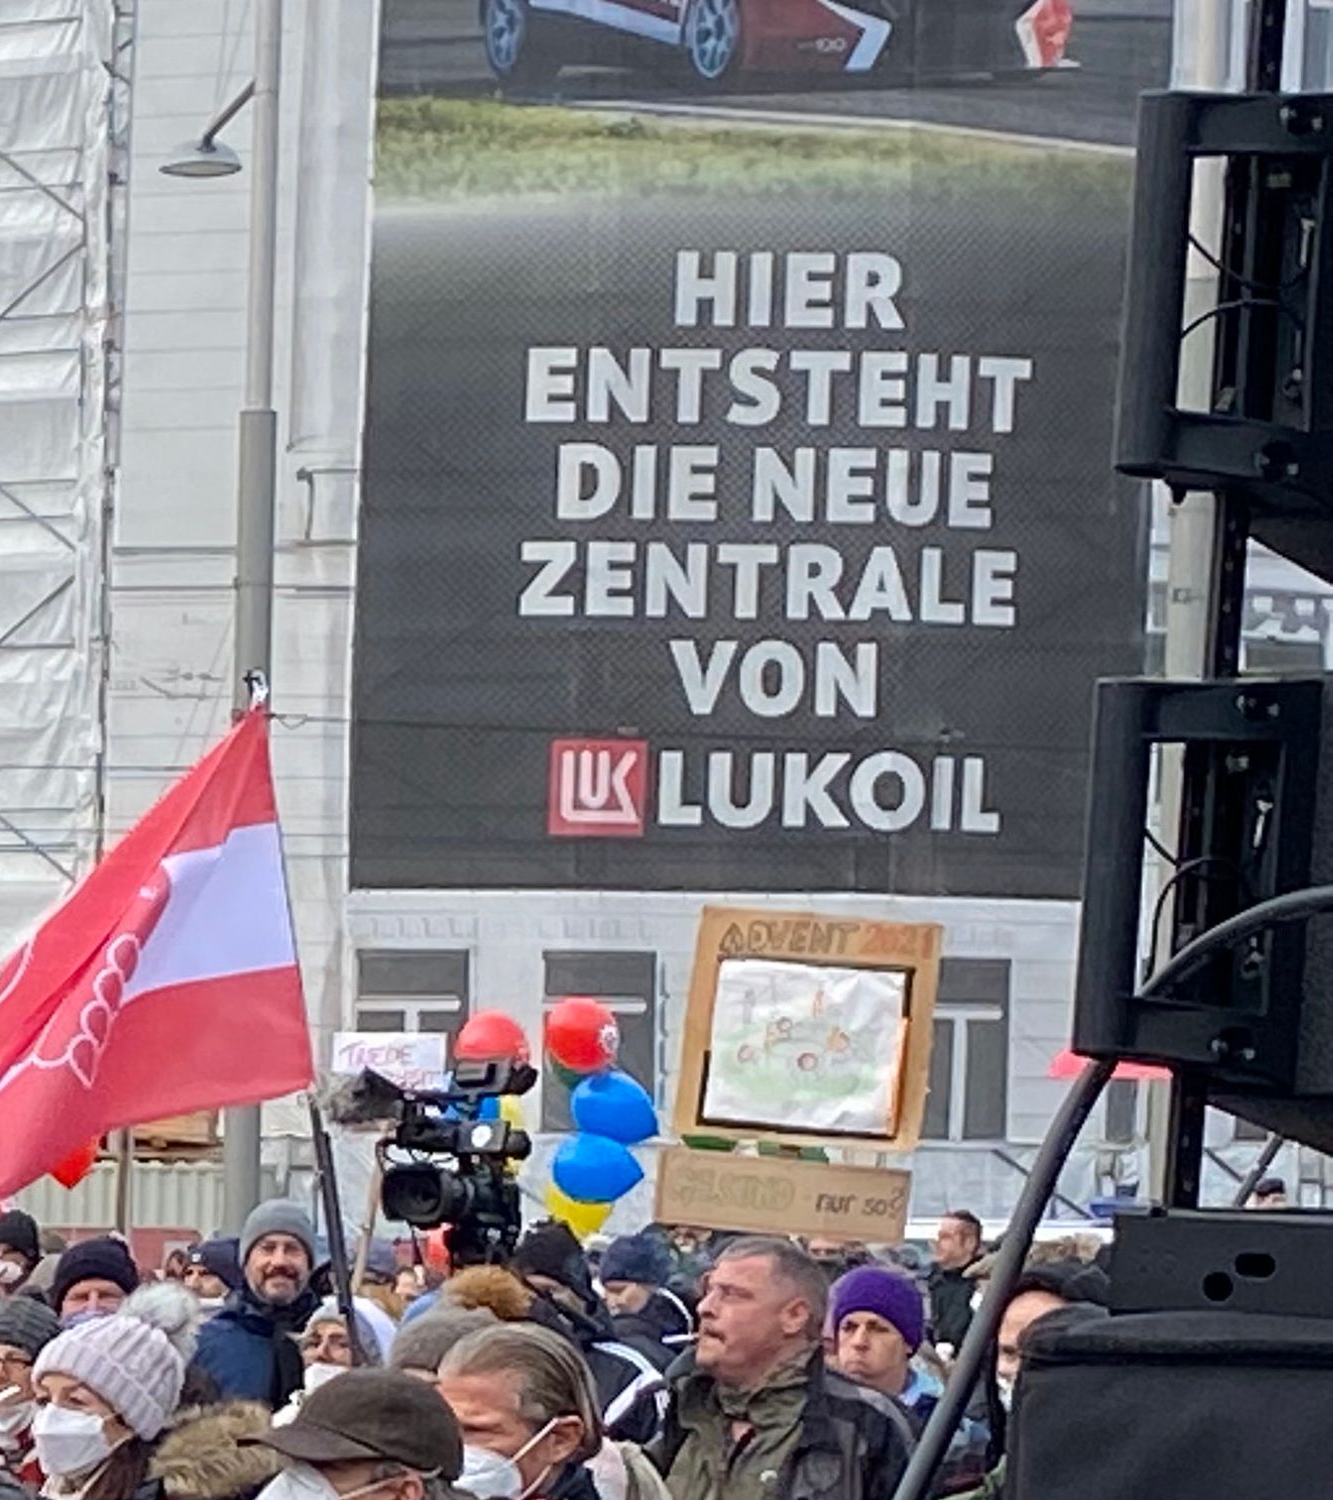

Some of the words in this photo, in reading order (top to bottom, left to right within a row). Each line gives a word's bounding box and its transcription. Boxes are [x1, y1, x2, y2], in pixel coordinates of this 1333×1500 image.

[675, 250, 905, 329] HIER
[524, 346, 1033, 434] ENTSTEHT
[556, 443, 720, 522] DIE
[752, 446, 994, 529] NEUE
[519, 541, 1018, 626] ZENTRALE
[669, 639, 878, 718] VON
[658, 750, 1001, 833] LUKOIL
[719, 920, 860, 954] ADVENT
[815, 1192, 856, 1214] nur
[862, 1186, 905, 1218] so?
